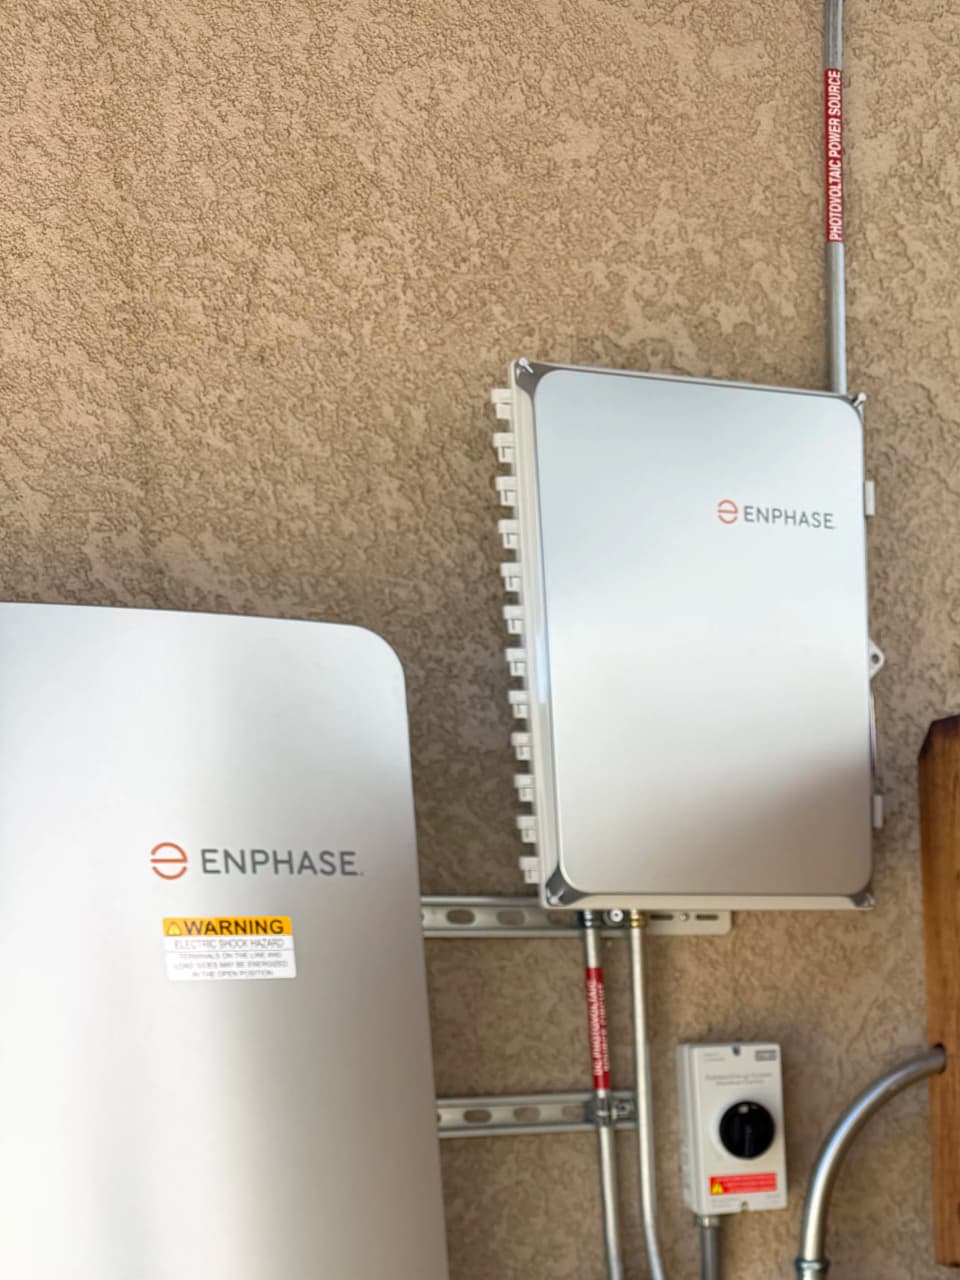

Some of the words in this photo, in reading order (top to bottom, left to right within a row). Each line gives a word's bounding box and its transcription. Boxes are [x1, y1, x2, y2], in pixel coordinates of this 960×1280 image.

[828, 70, 841, 116] SOURCE
[828, 117, 842, 158] POWER
[828, 159, 842, 241] PHOTOVOLTAIC
[744, 505, 833, 529] ENPHASE
[183, 919, 284, 935] WARNING
[174, 939, 217, 950] ELECTRIC
[219, 939, 248, 949] SHOCK
[250, 938, 284, 949] HAZARD
